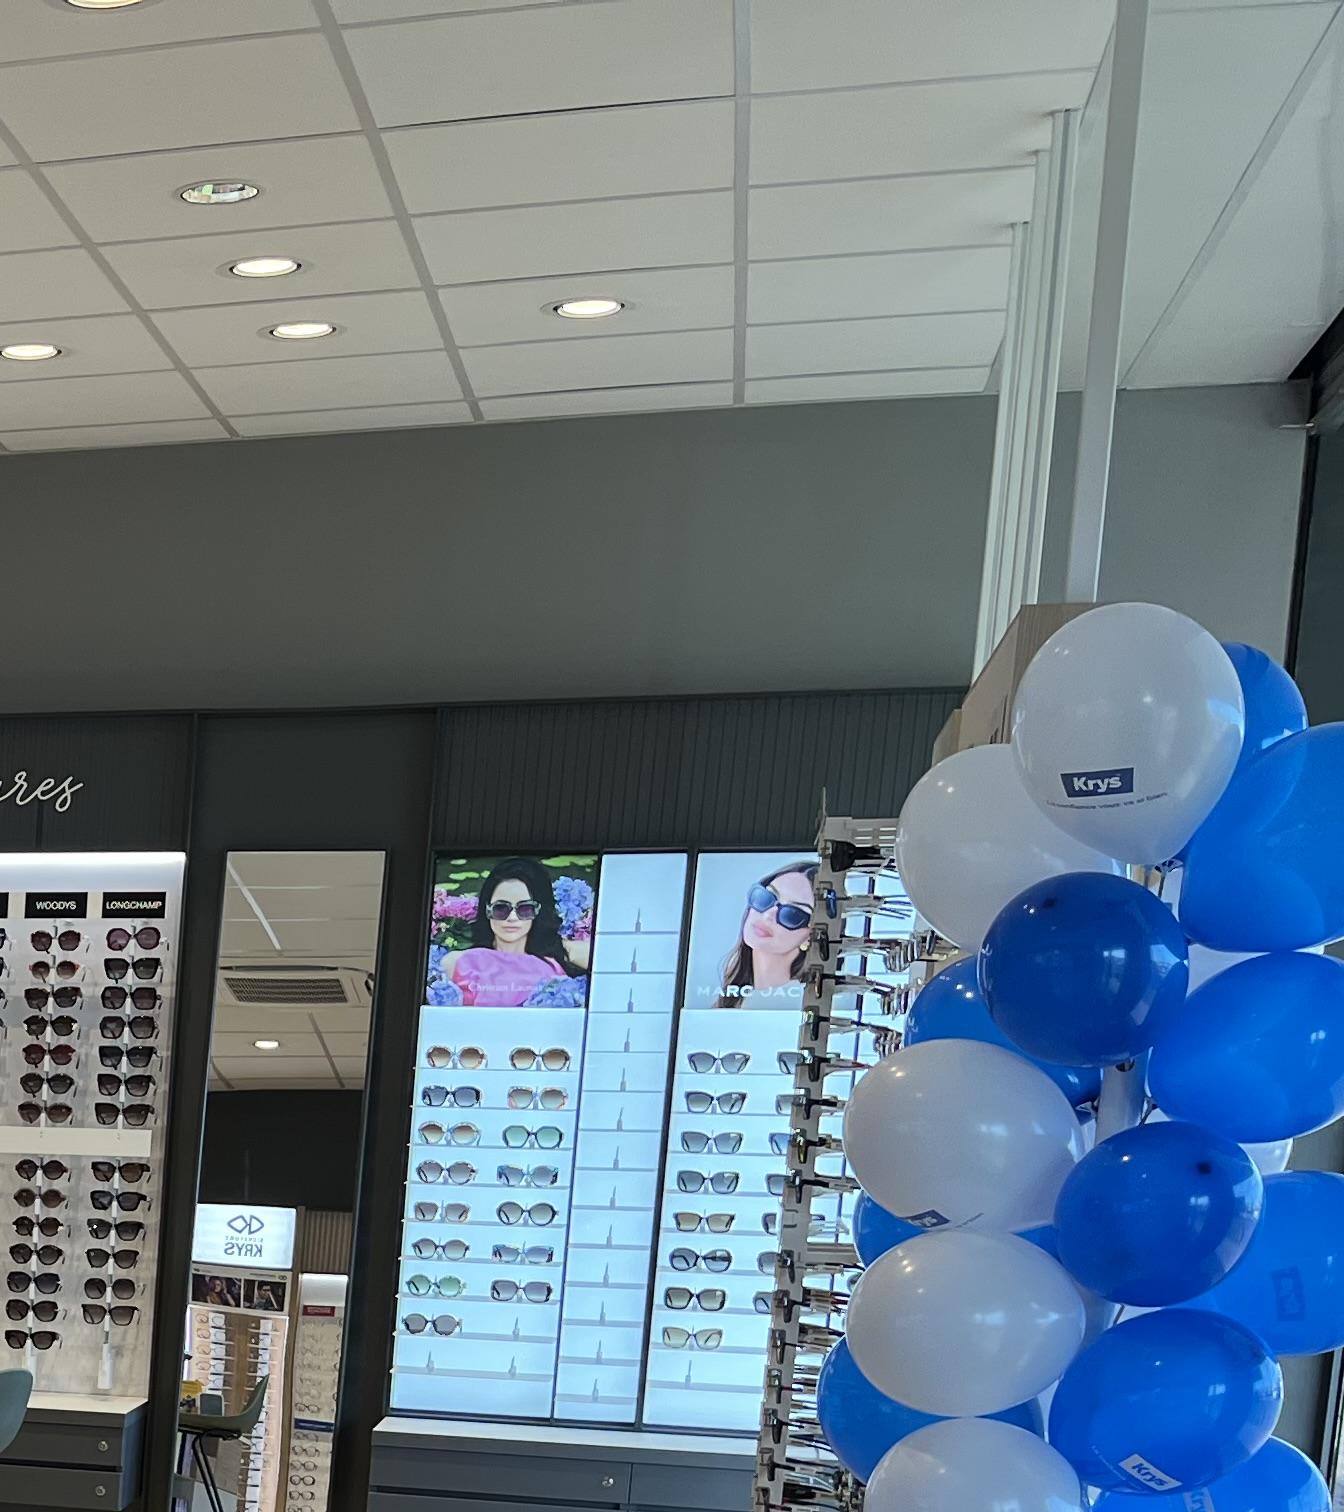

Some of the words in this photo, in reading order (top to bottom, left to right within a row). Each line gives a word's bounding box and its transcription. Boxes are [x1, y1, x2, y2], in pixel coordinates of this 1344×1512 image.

[1072, 775, 1122, 794] Krys
[35, 899, 77, 912] WOODYS
[105, 899, 163, 911] LONGCHAMP
[467, 982, 508, 994] Christian
[696, 983, 753, 999] MARC
[1131, 1462, 1170, 1487] Krys
